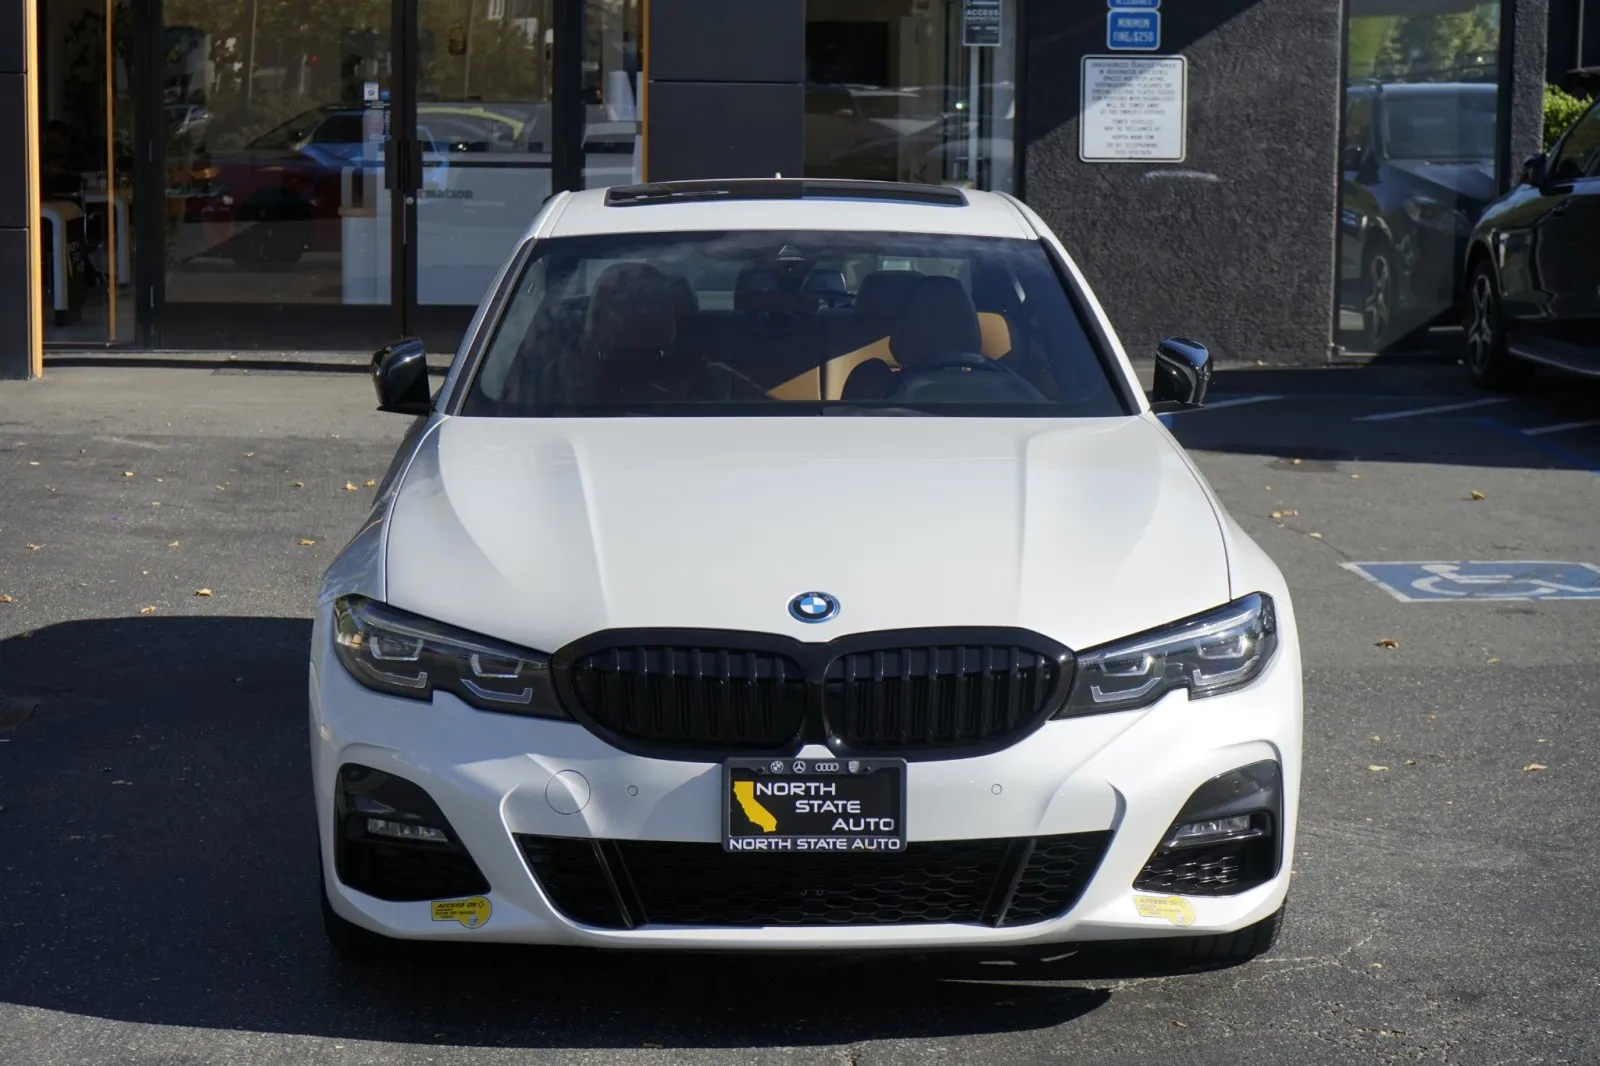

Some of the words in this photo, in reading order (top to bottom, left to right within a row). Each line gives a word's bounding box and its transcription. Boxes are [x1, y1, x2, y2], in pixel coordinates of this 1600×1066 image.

[756, 782, 836, 796] NORTH
[795, 800, 861, 813] STATE
[831, 818, 894, 831] AUTO
[729, 838, 792, 850] NORTH
[796, 838, 848, 850] STATE
[851, 838, 900, 850] AUTO
